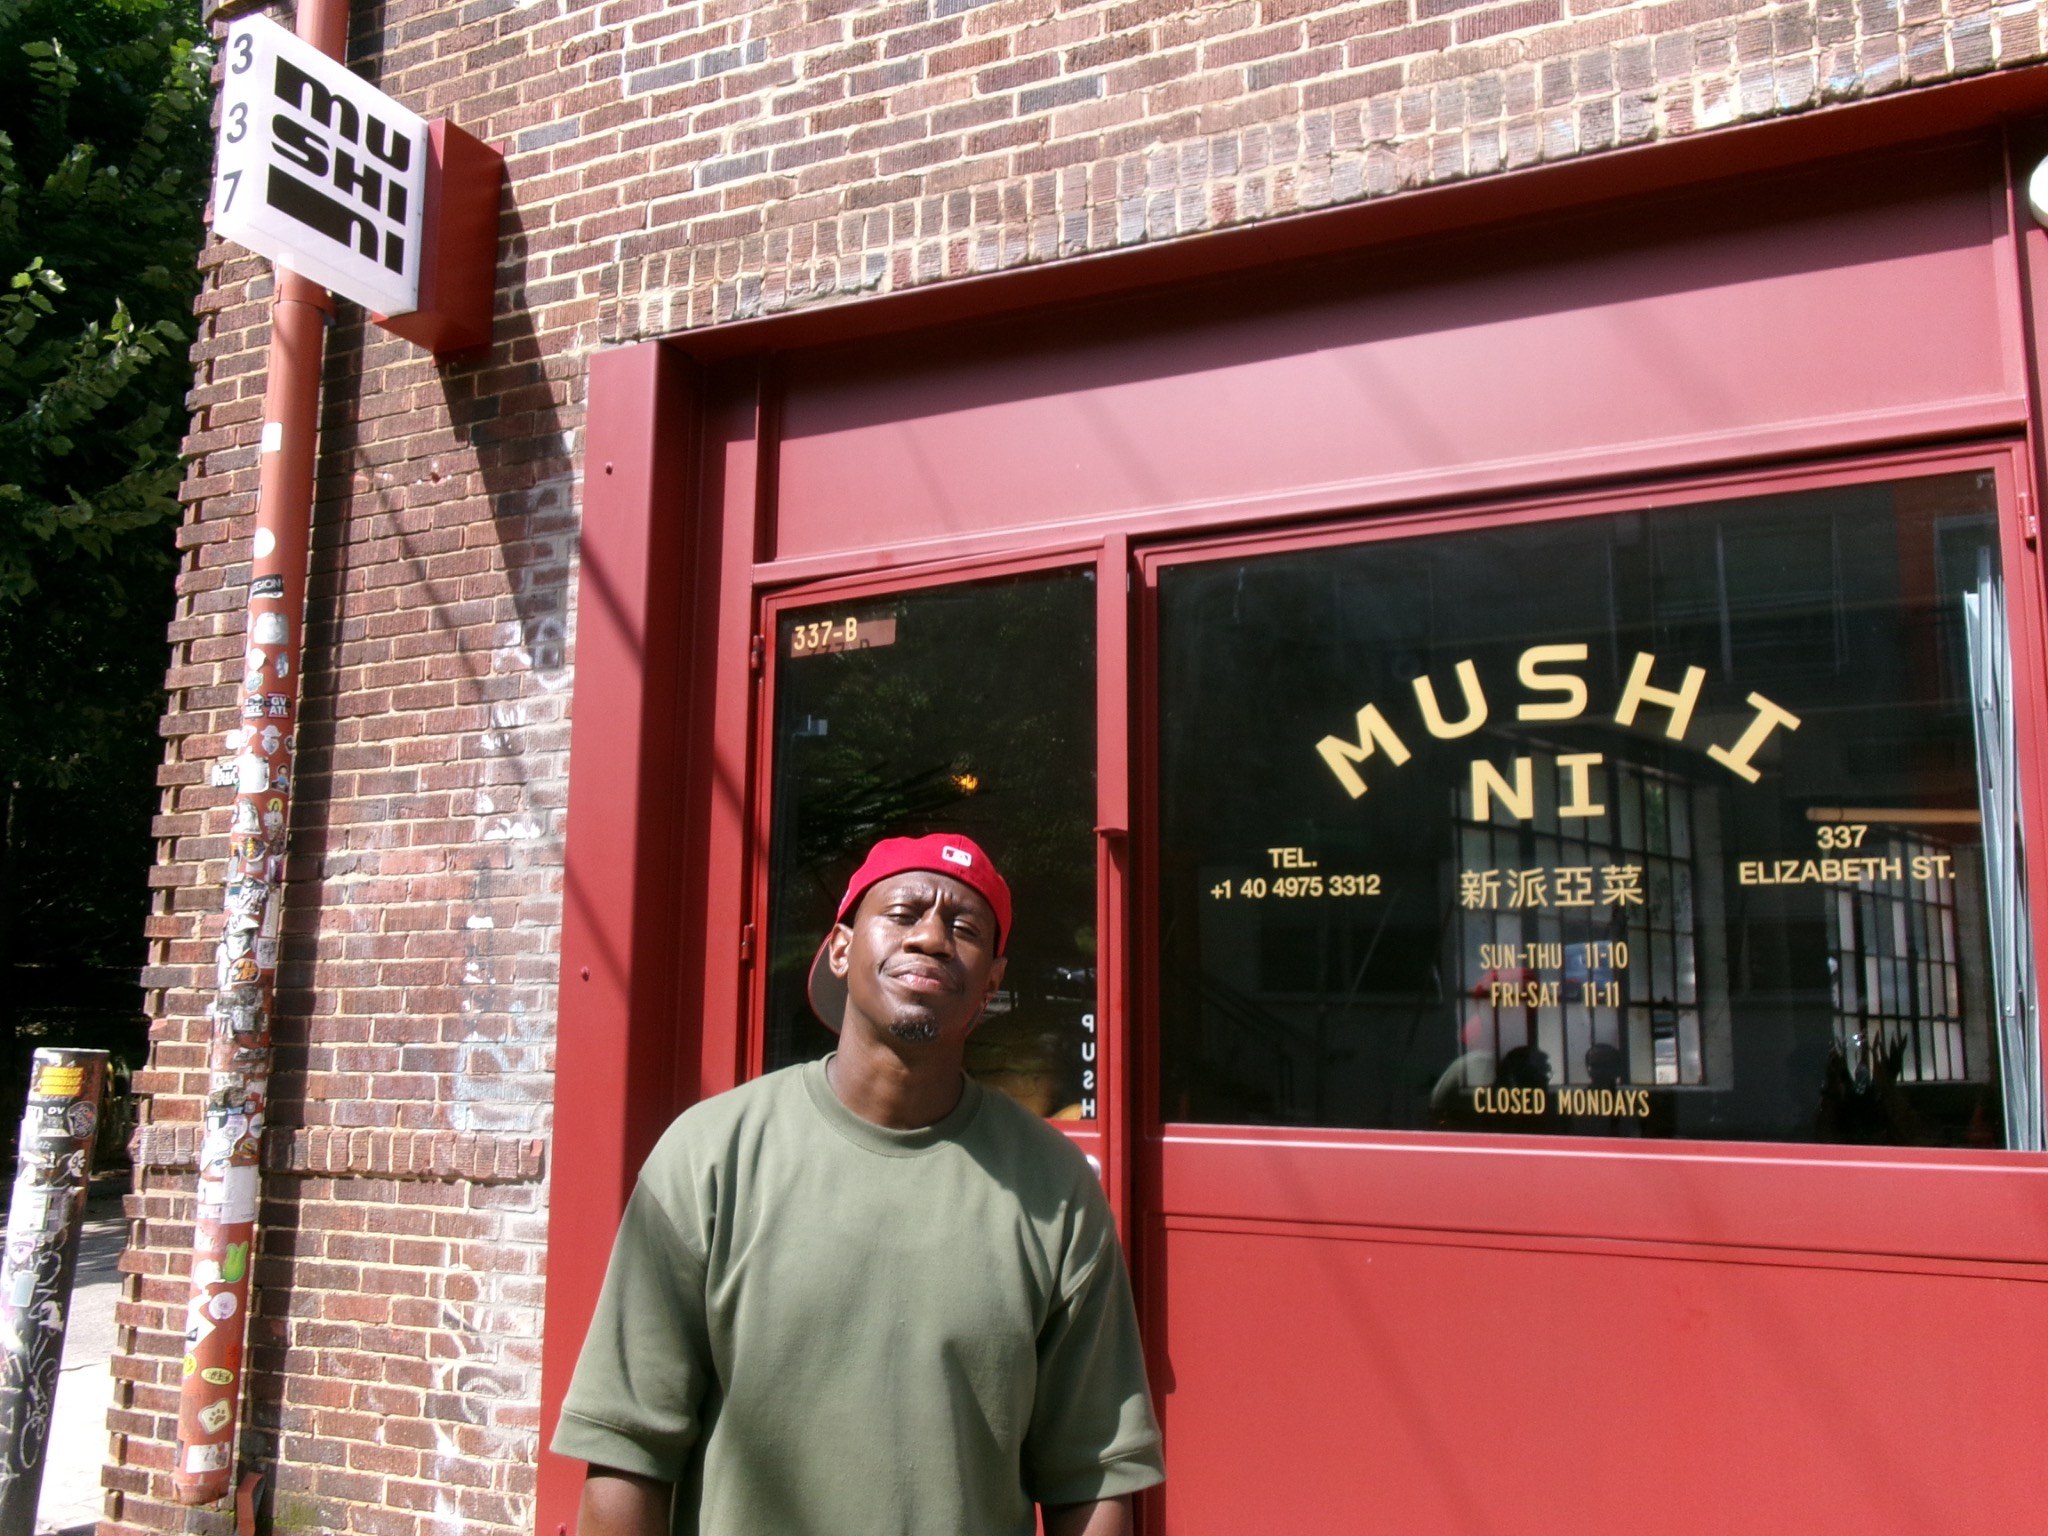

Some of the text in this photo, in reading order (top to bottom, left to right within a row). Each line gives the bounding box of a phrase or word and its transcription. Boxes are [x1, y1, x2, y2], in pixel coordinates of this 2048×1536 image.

[793, 616, 857, 651] 337-B
[269, 705, 288, 715] ATL
[1315, 642, 1801, 799] MUSHI
[1470, 752, 1606, 822] NI
[1816, 824, 1868, 850] 337
[1267, 847, 1318, 869] TEL.
[1738, 855, 1956, 885] ELIZABETH ST.
[1210, 873, 1382, 900] +1 40 4975 3312
[1460, 863, 1645, 910] 新派亞菜
[1480, 941, 1629, 970] SUN-THU 11-10
[1490, 980, 1620, 1008] FRI-SAT 11-11
[1473, 1086, 1651, 1118] CLOSED MONDAYS
